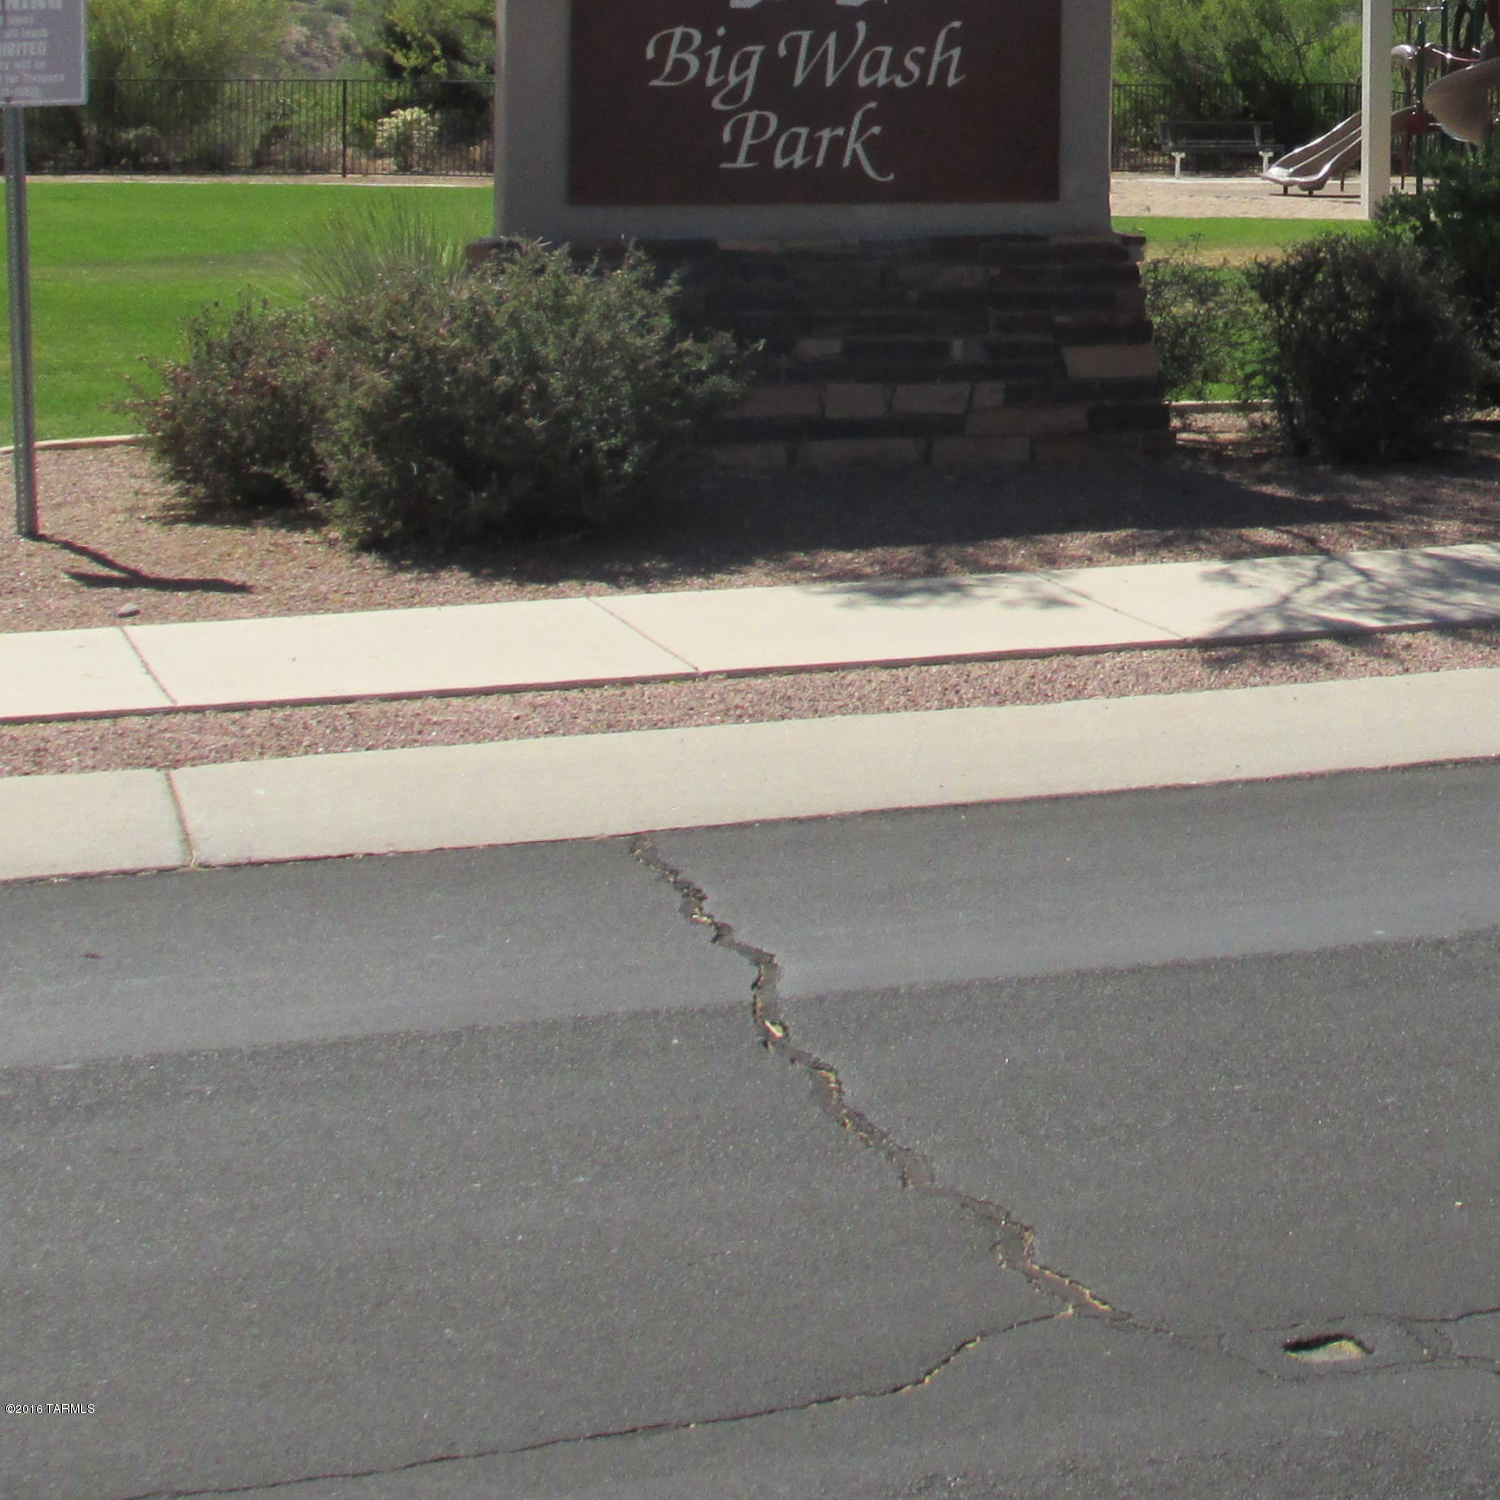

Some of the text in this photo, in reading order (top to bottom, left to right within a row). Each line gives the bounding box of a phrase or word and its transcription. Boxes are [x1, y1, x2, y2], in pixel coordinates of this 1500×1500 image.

[646, 20, 965, 110] Big Wash
[720, 101, 894, 181] Park
